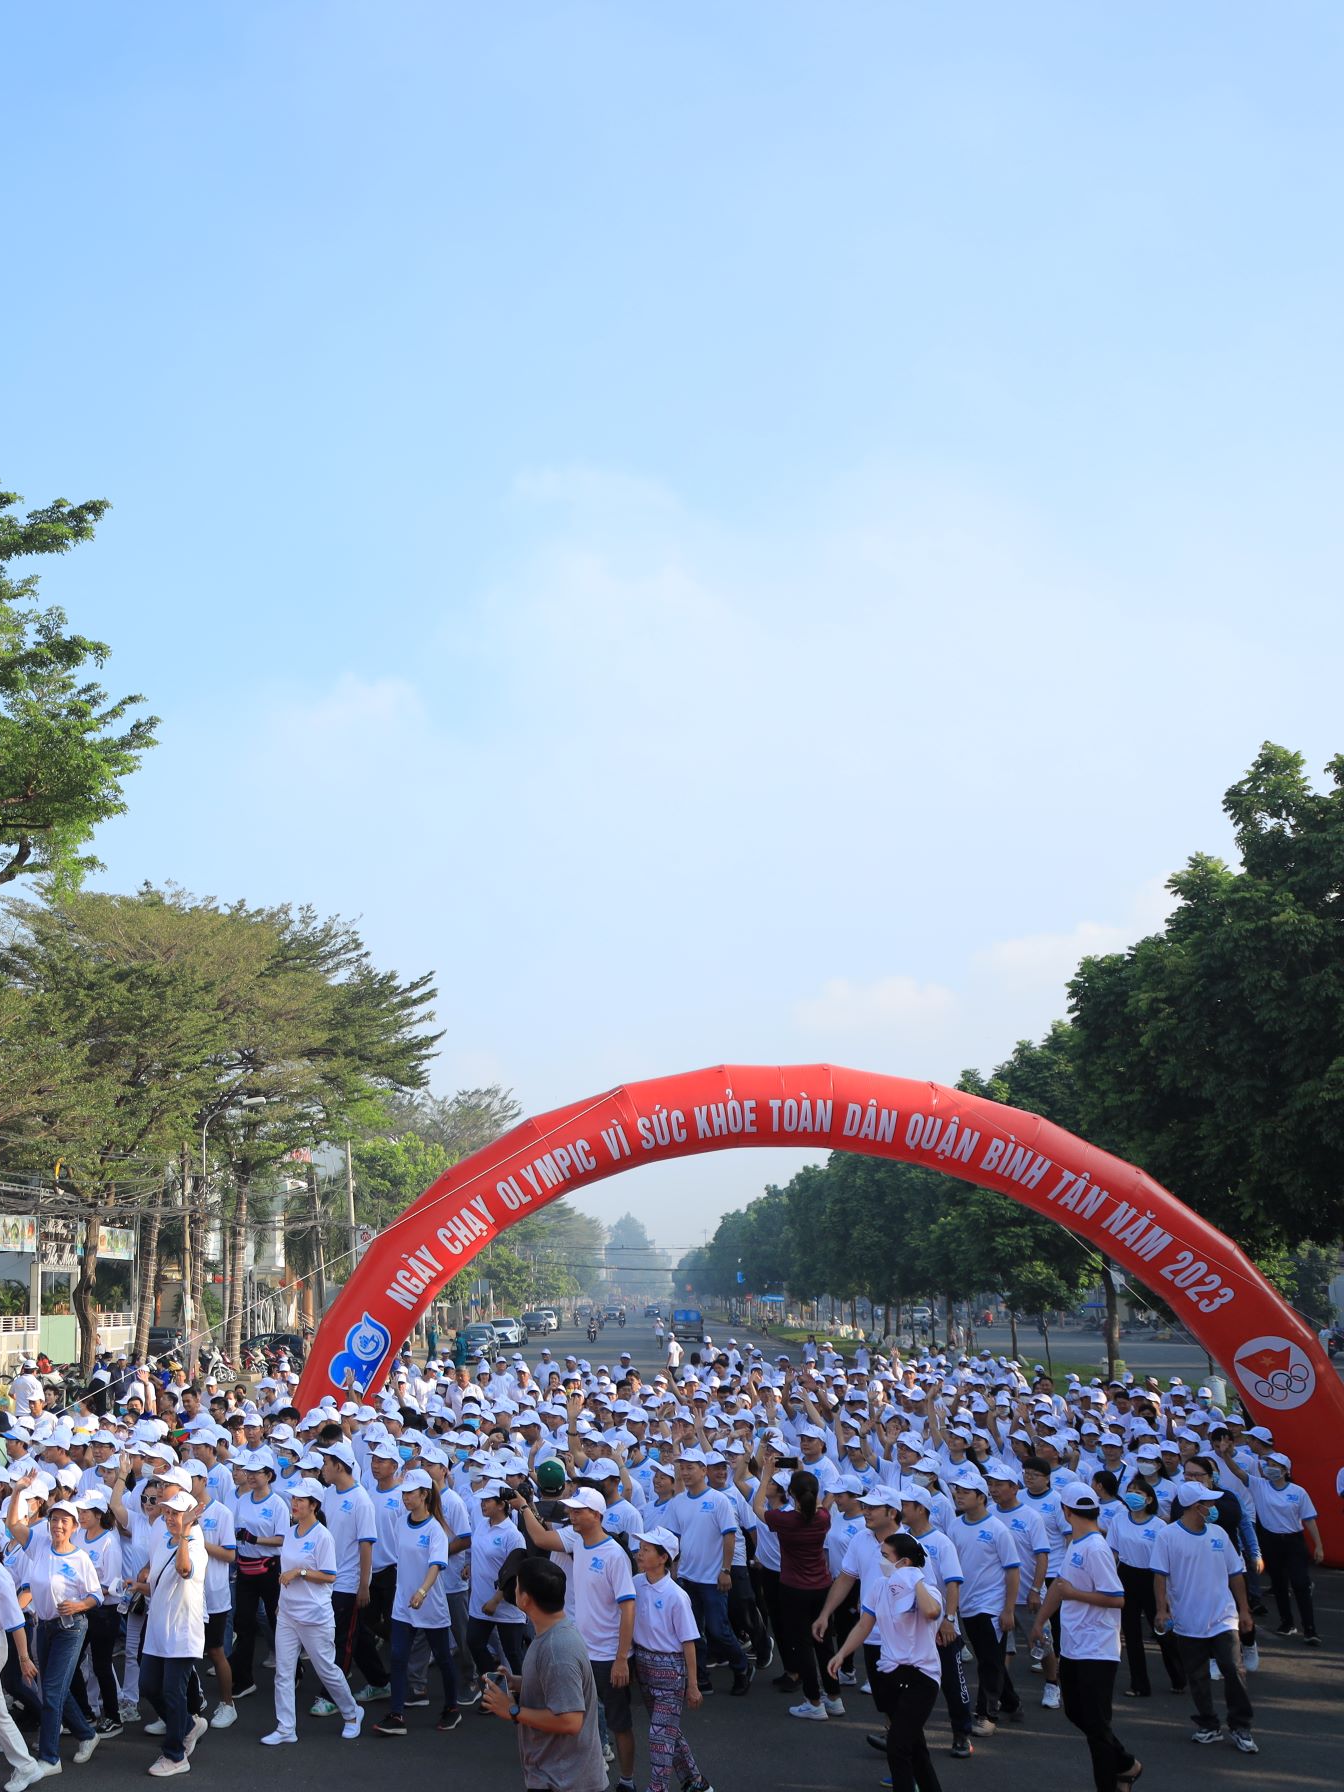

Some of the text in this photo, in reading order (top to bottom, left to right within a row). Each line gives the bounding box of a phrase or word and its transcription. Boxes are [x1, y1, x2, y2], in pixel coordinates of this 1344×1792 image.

[385, 1088, 1235, 1313] NGÀY CHẠY OLYMPIC VÌ SỨC KHỎE TOÀN DÂN QUẬN BÌNH TÂN NĂM 2023
